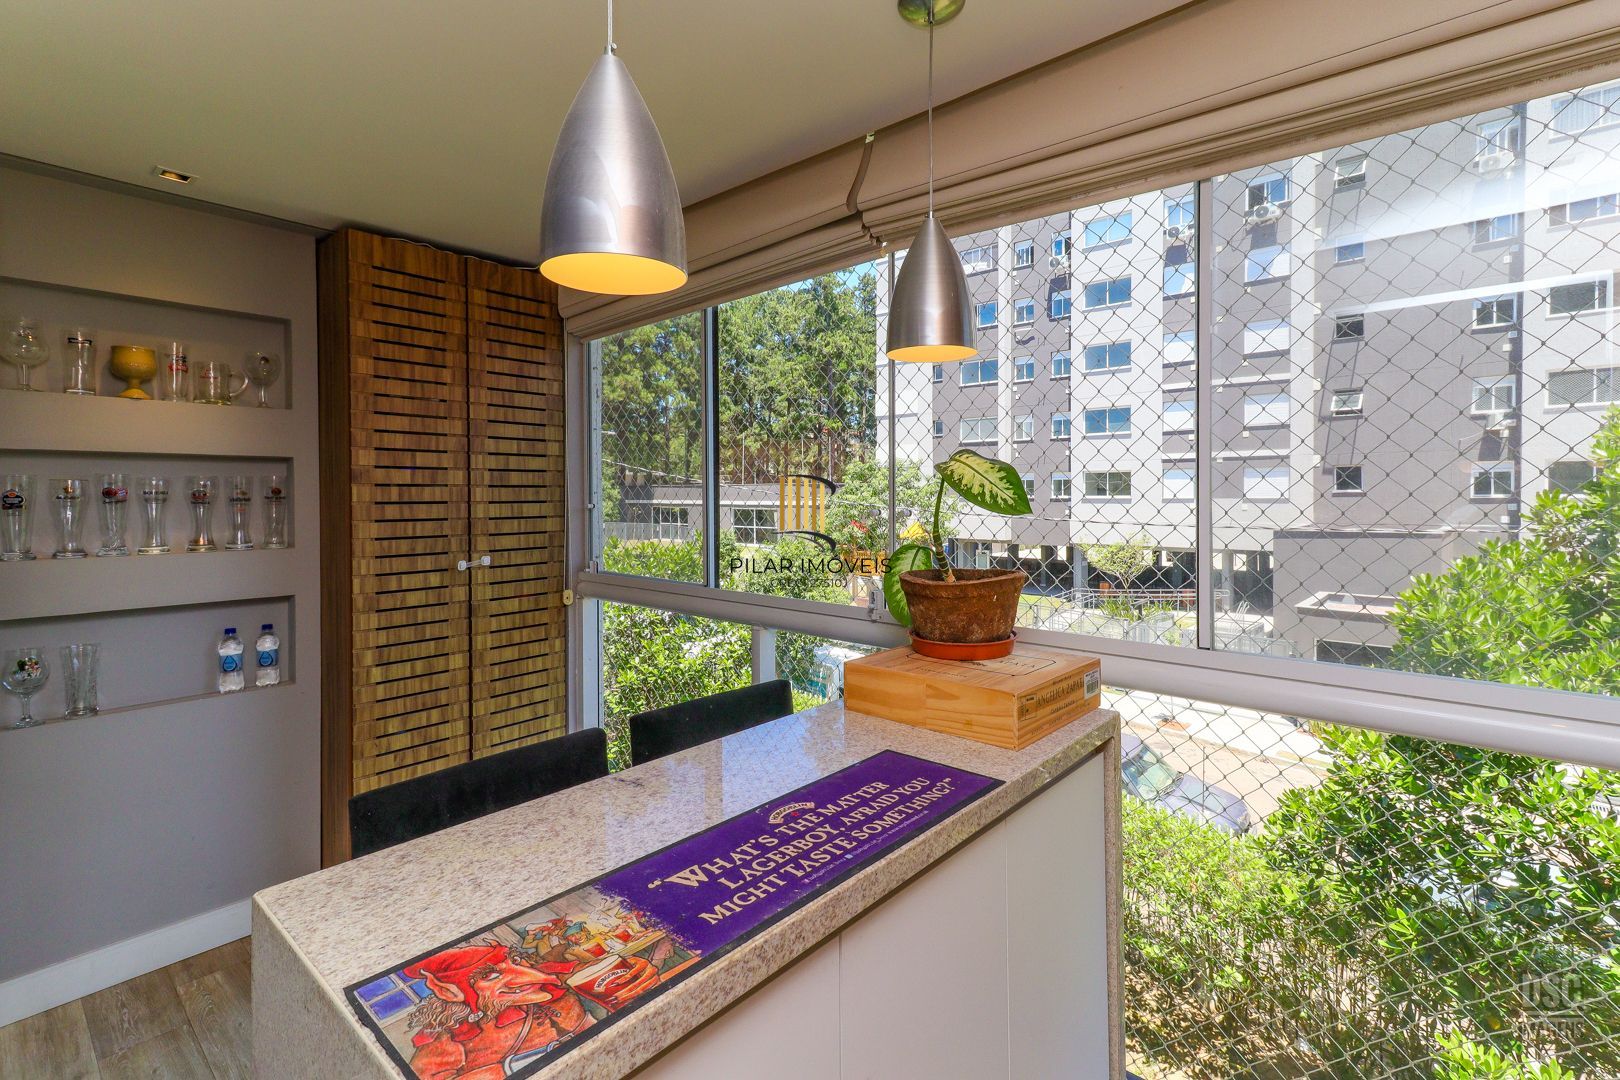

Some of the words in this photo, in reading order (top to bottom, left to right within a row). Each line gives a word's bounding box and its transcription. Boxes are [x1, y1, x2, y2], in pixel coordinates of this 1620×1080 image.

[774, 812, 824, 836] THE
[816, 781, 890, 817] MATTER
[839, 793, 900, 827] AFRAID
[894, 777, 931, 796] YOU
[697, 873, 788, 925] MIGHT
[779, 836, 859, 878] TASTE
